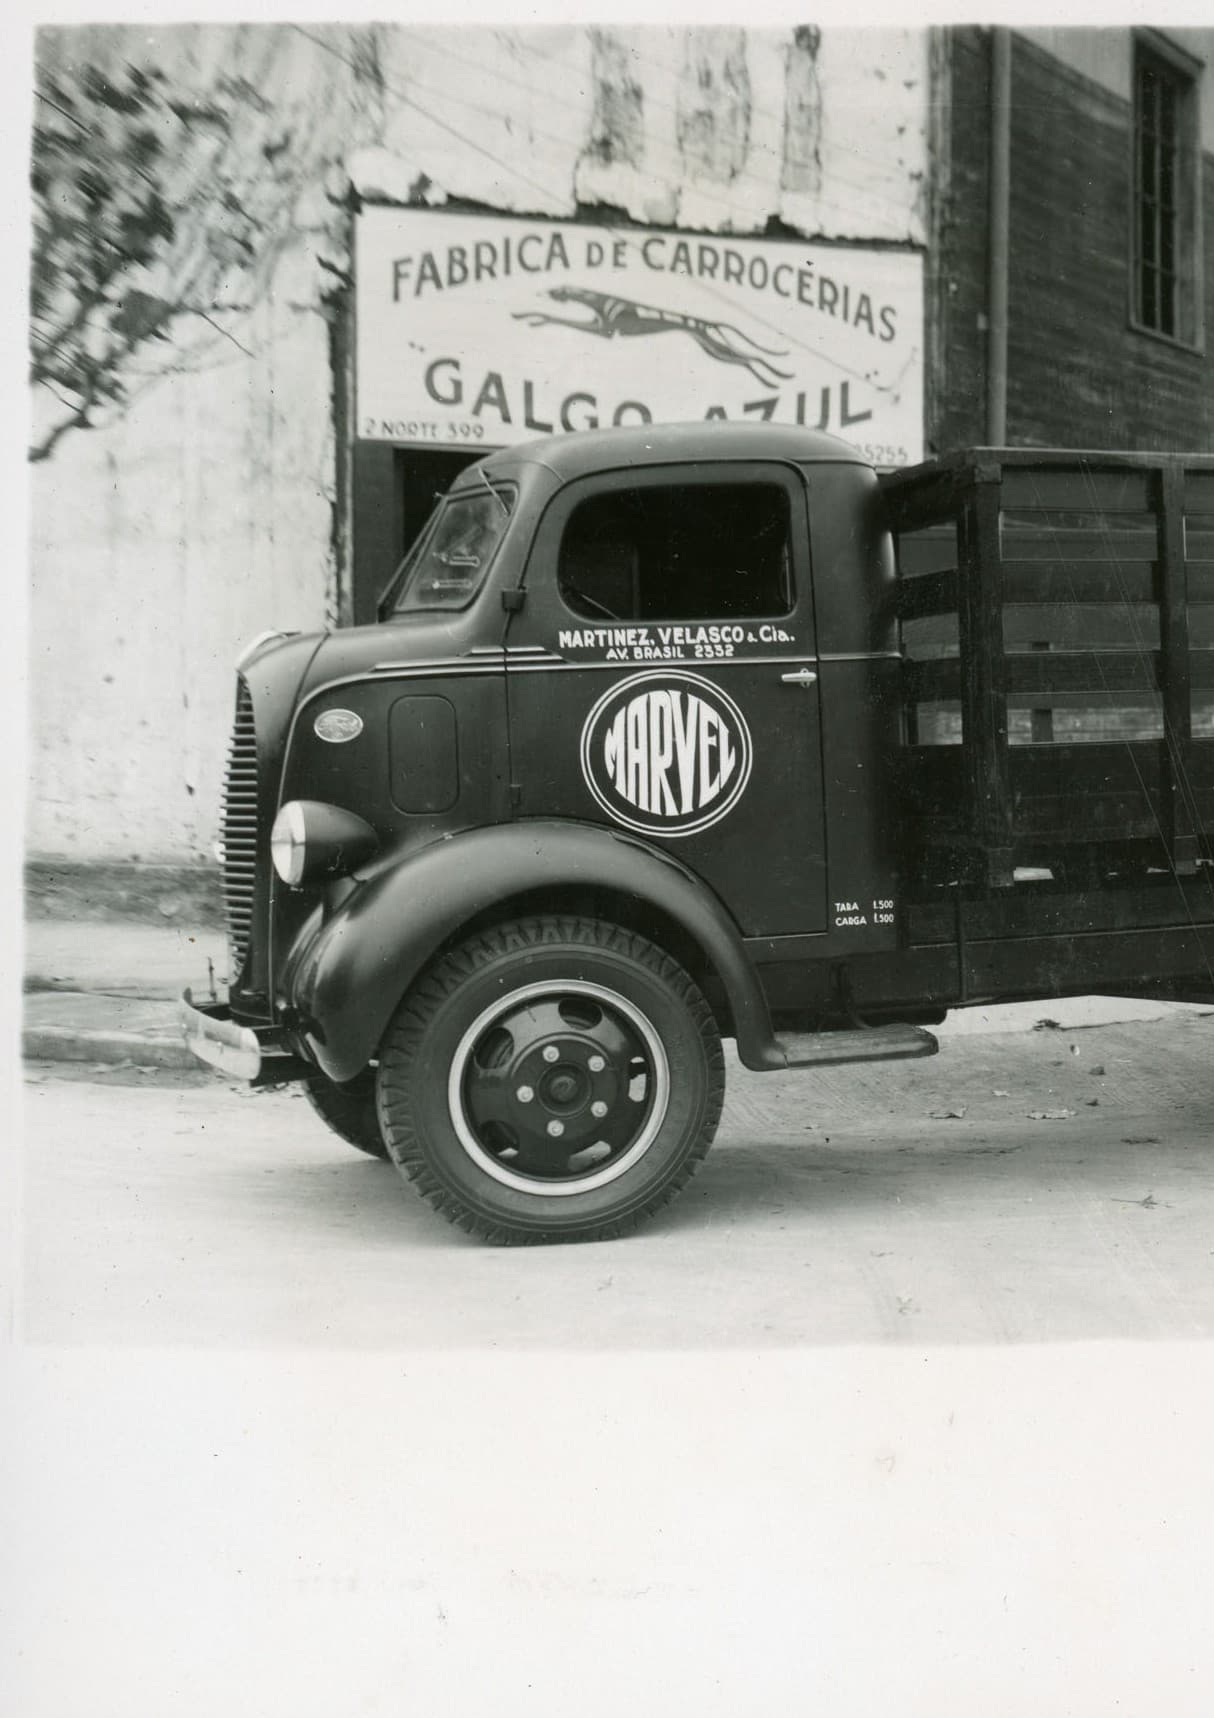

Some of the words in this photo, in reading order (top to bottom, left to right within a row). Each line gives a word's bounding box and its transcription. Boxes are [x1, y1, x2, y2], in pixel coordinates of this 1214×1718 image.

[392, 232, 570, 303] FABRICA
[586, 239, 627, 268] DE
[642, 238, 897, 342] CARROCERIAS
[657, 626, 743, 645] VELASCO
[605, 648, 629, 660] AV.
[634, 646, 685, 660] BRASIL
[604, 689, 735, 816] MARVEL
[835, 916, 867, 926] CARGA
